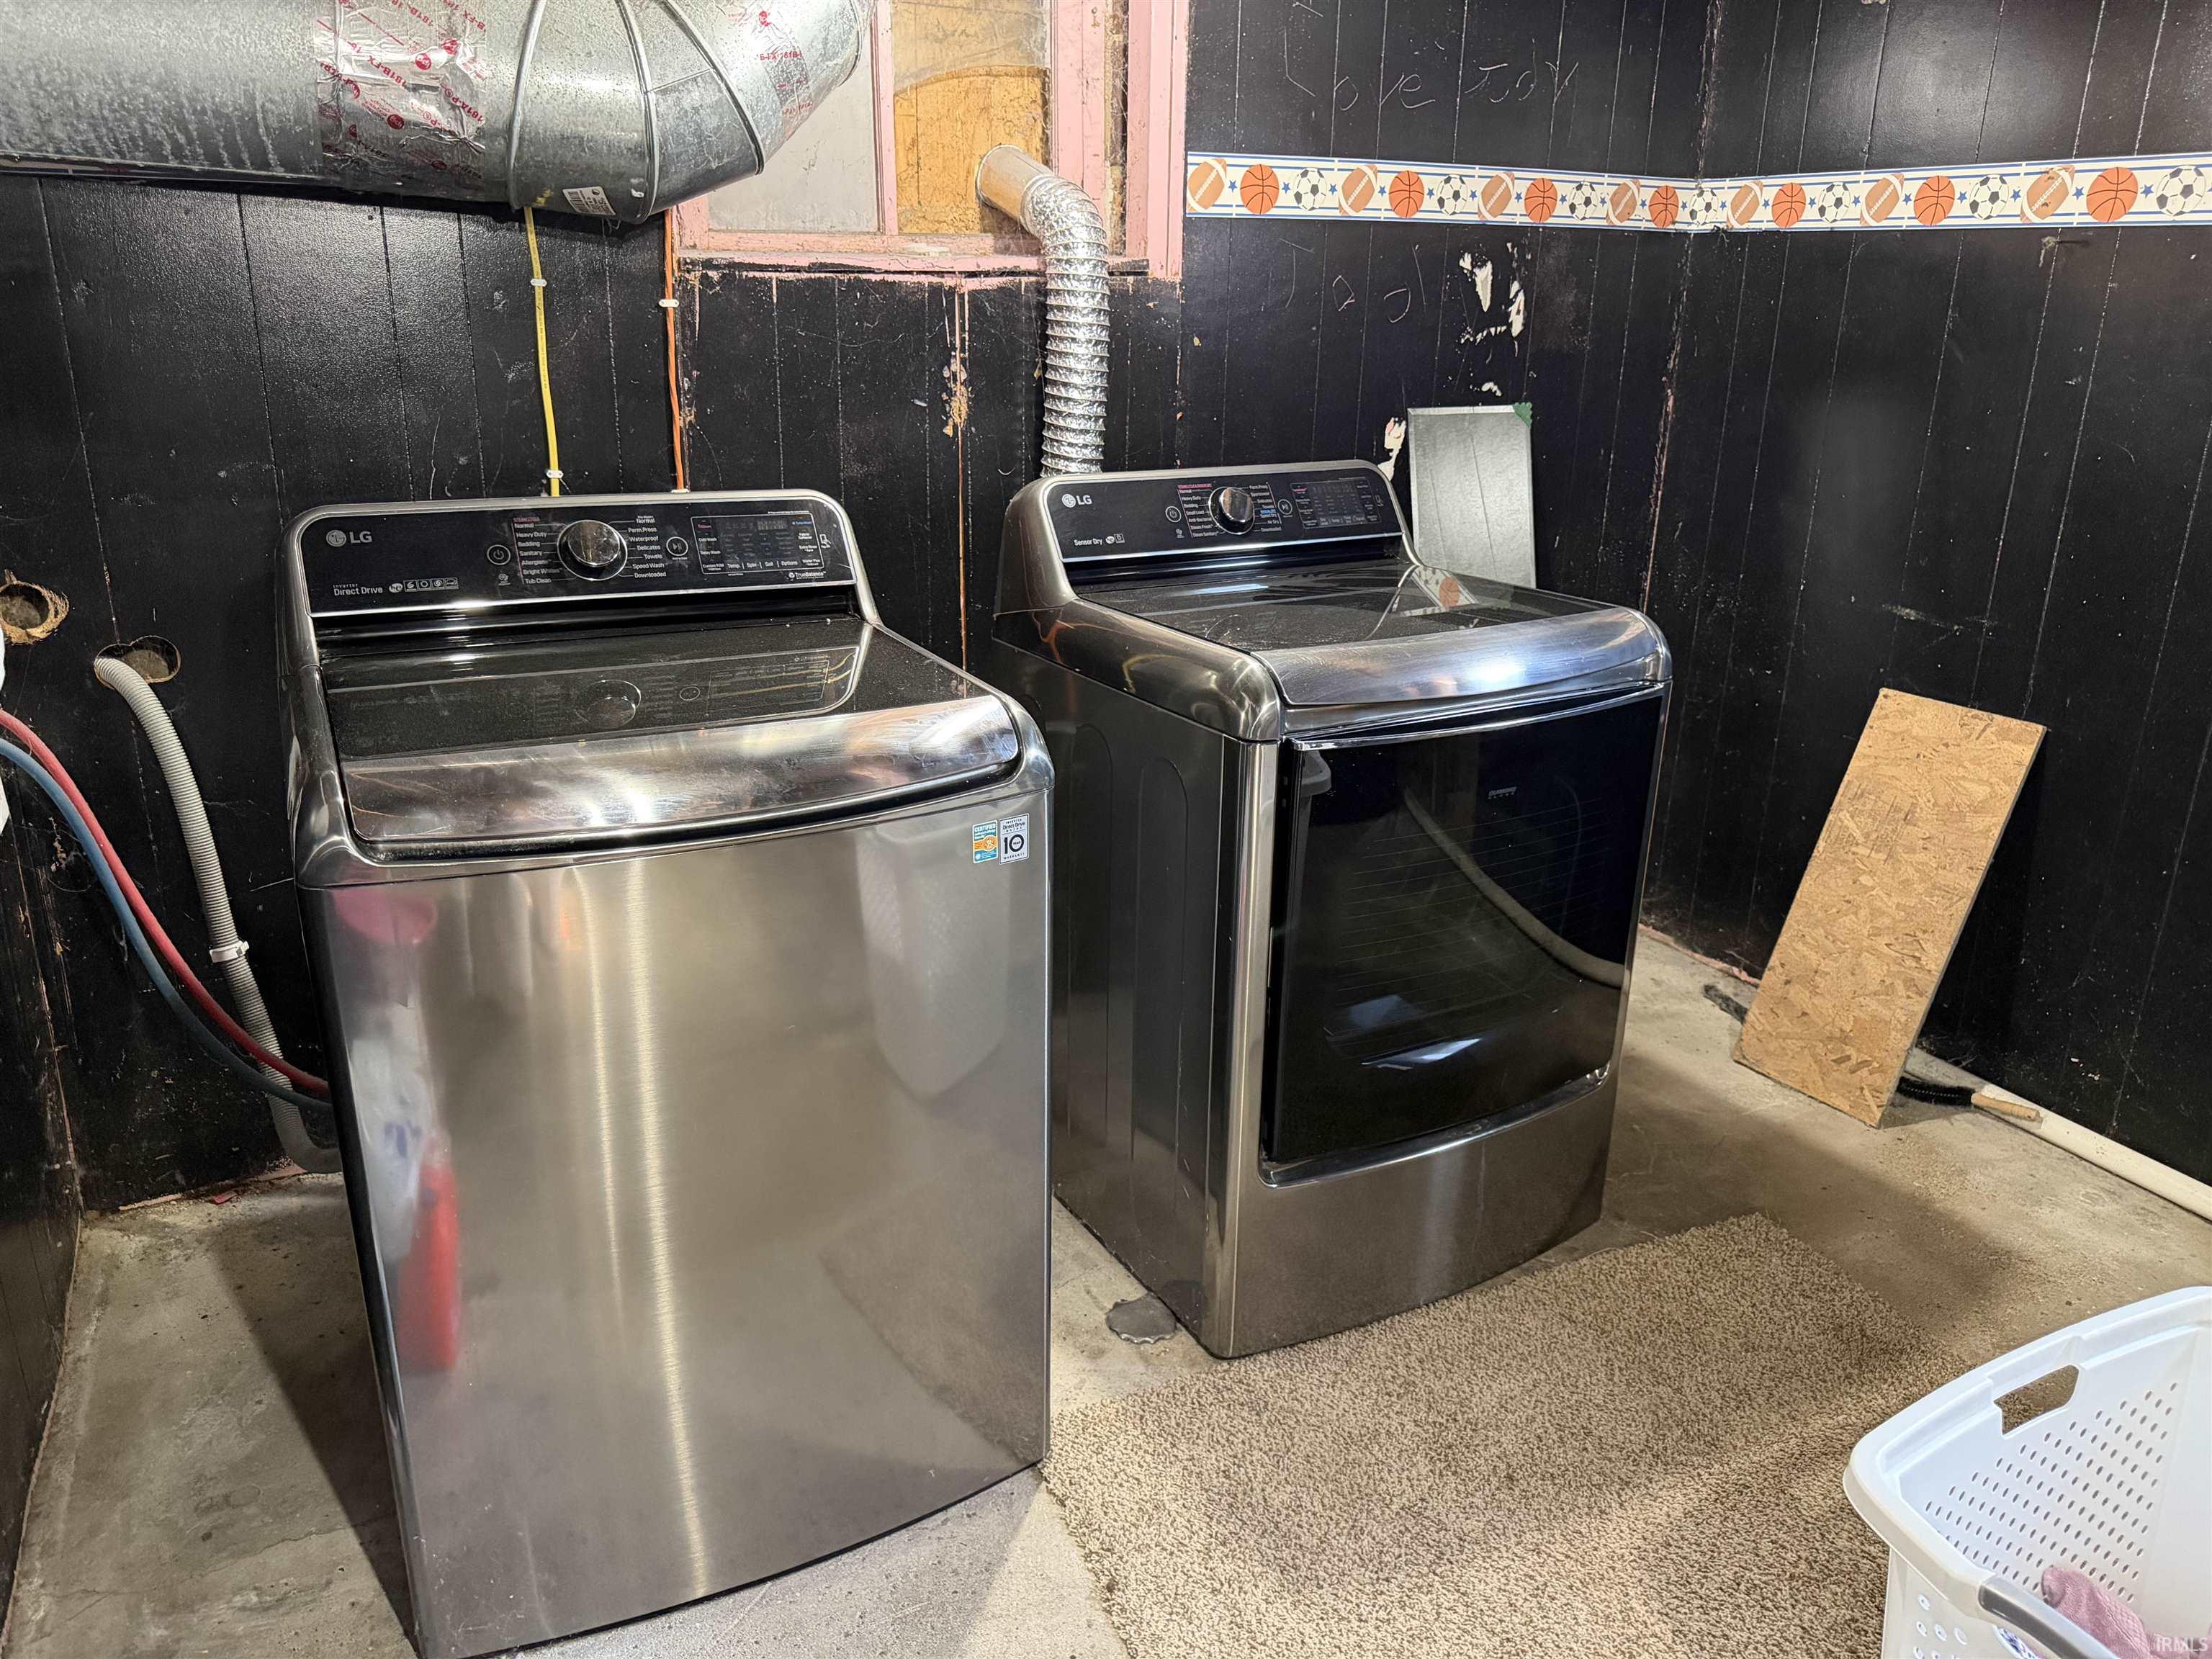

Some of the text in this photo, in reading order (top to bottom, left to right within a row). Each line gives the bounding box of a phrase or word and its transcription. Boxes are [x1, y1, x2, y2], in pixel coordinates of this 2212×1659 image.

[1076, 495, 1092, 505] LG
[349, 531, 372, 544] LG
[1004, 834, 1025, 855] 10
